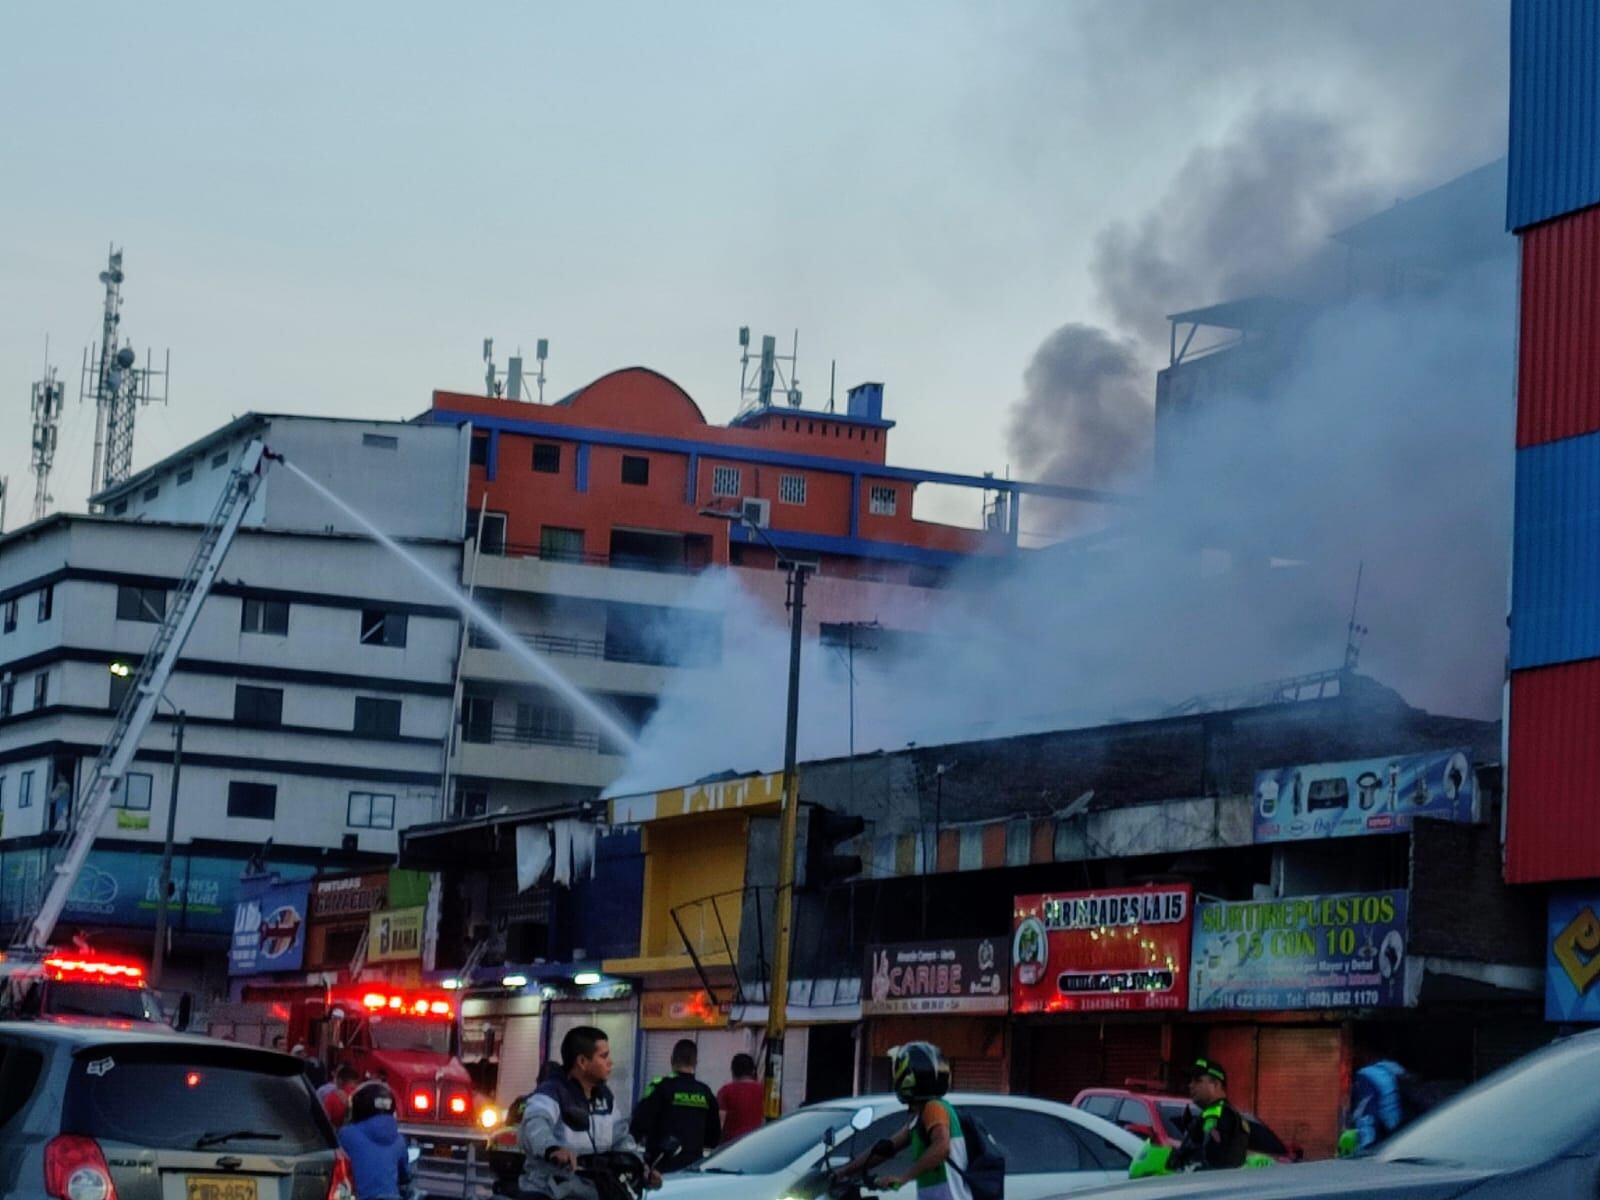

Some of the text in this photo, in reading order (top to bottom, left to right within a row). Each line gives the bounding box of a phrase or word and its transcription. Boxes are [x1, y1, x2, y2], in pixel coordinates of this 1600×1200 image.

[1143, 893, 1161, 921] LA
[1164, 892, 1182, 920] 15
[1269, 928, 1315, 957] CON
[1326, 926, 1356, 955] 10
[889, 963, 962, 996] CARIBE
